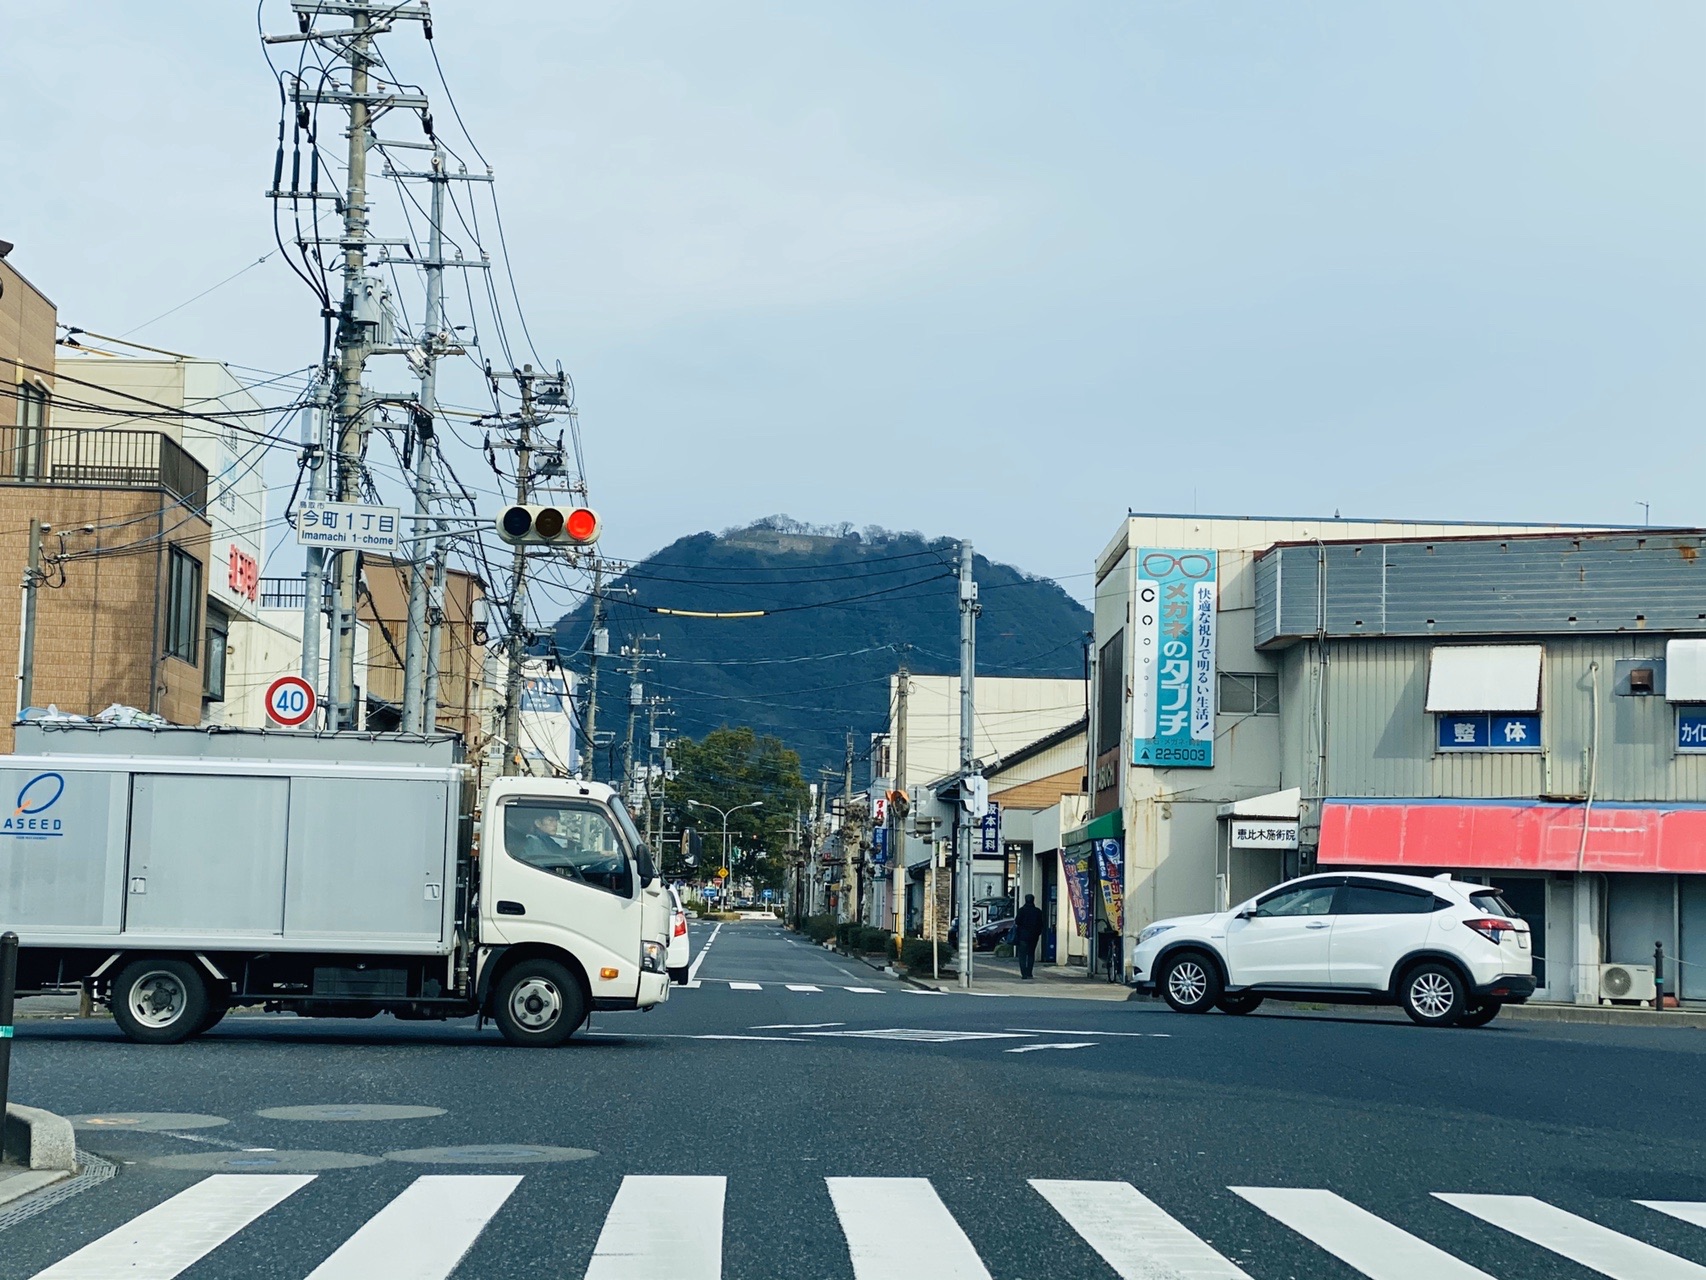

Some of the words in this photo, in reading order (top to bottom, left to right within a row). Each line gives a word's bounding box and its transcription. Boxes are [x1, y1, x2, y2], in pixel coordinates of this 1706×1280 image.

[303, 510, 393, 532] 今町1丁目
[302, 530, 346, 541] Imamachi
[352, 534, 393, 545] 1-chome
[1160, 583, 1190, 736] メガネのタブチ
[276, 690, 304, 712] 40
[1454, 722, 1526, 742] 整体
[1155, 748, 1205, 761] 22-5003
[4, 818, 61, 830] ASEED
